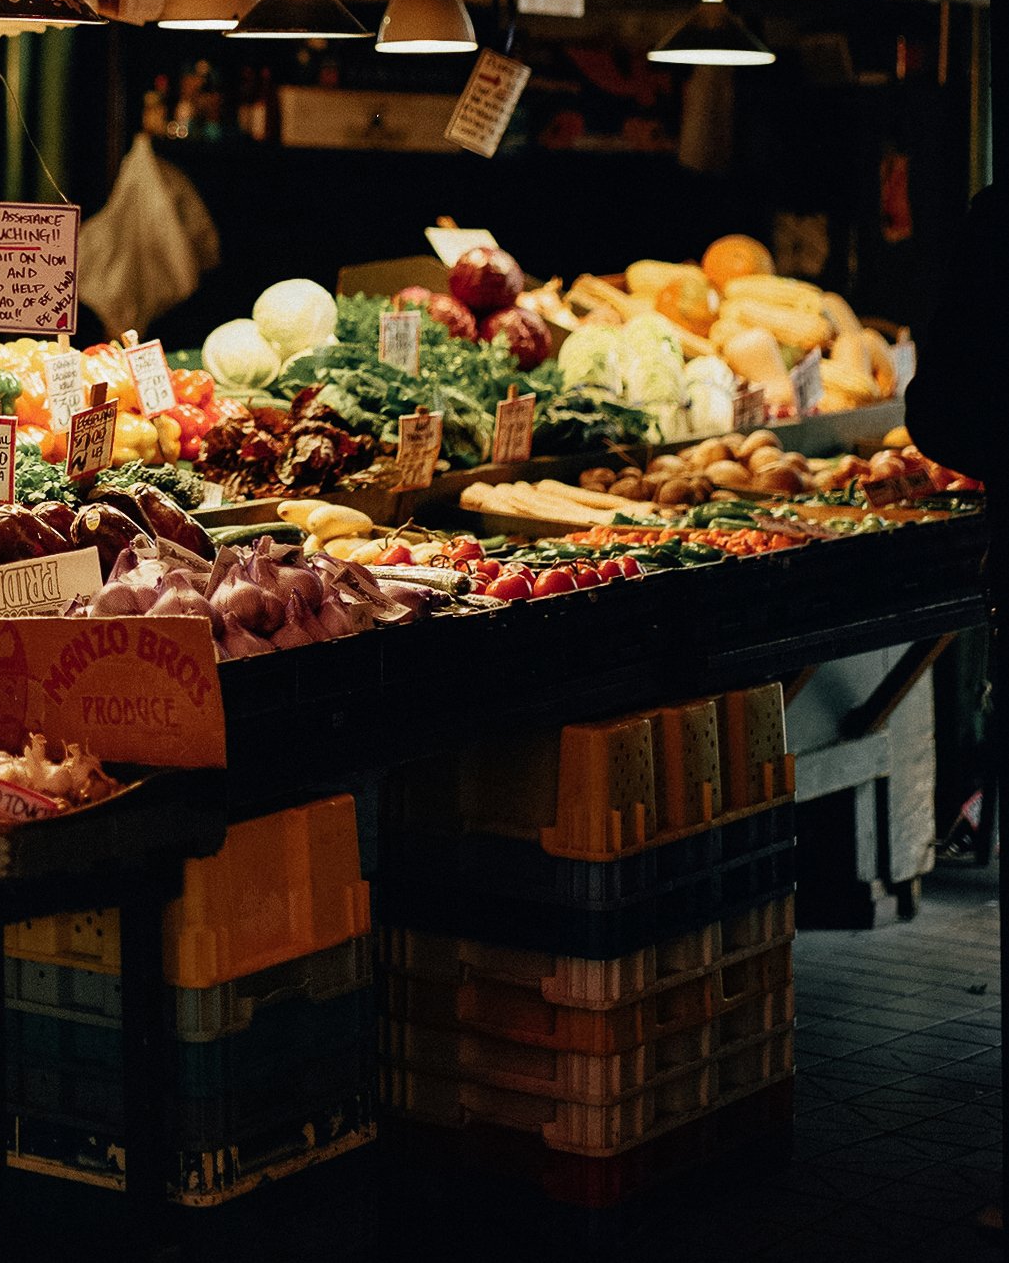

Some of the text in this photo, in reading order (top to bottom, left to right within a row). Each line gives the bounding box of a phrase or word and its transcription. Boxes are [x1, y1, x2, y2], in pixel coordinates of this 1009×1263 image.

[1, 210, 65, 226] ASSISTANCE
[20, 253, 36, 264] ON
[40, 254, 66, 266] YOU
[7, 267, 37, 279] AND
[12, 283, 45, 294] HELP
[38, 270, 74, 306] BE KIND
[23, 297, 36, 308] OF
[35, 294, 73, 326] BE WELL
[42, 621, 129, 705] MANZO
[82, 696, 178, 728] PRODUCE
